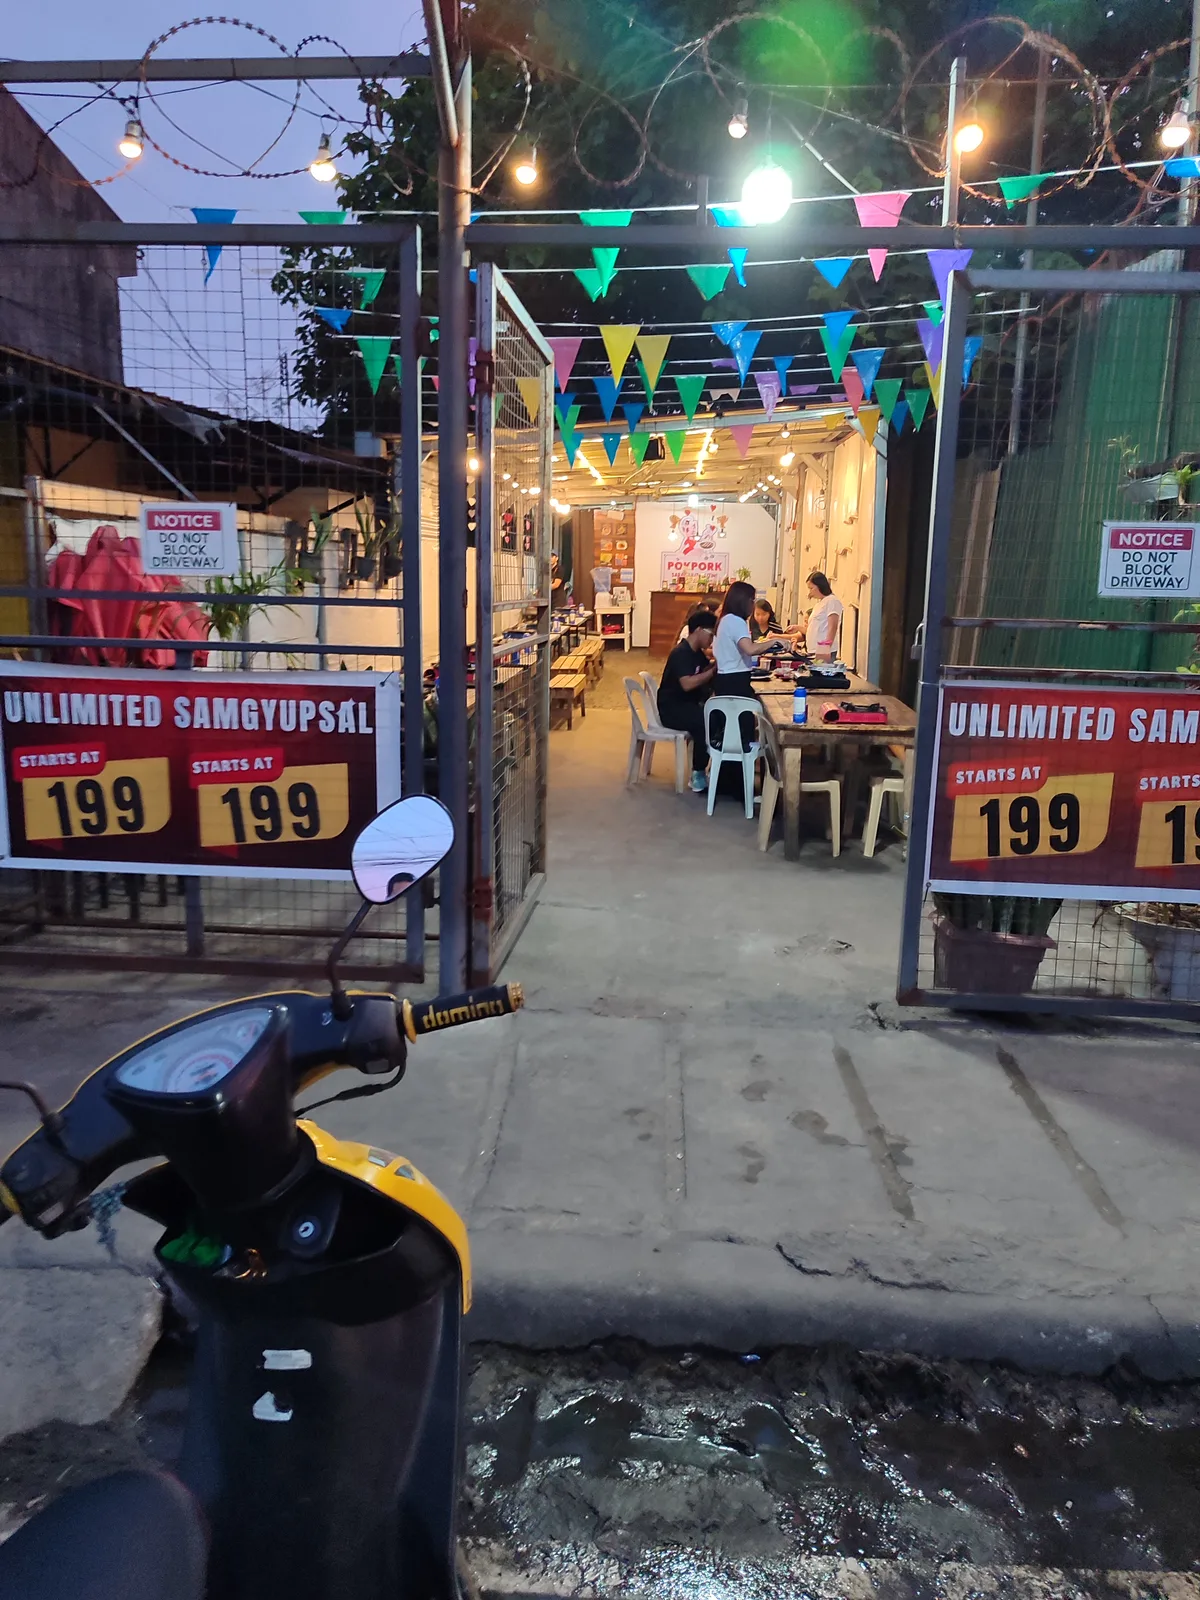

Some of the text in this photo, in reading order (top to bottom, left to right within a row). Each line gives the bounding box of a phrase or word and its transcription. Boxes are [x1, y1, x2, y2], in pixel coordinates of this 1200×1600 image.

[154, 514, 214, 527] NOTICE
[159, 532, 210, 543] DO NOT
[1119, 532, 1184, 546] NOTICE
[164, 545, 207, 555] BLOCK
[1122, 551, 1178, 563] DO NOT
[152, 556, 219, 568] DRIVEWAY
[1125, 564, 1172, 575] BLOCK
[1111, 576, 1185, 588] DRIVEWAY
[4, 690, 374, 735] UNLIMITED SAMGYUPSAL
[948, 702, 1115, 742] UNLIMITED
[19, 749, 100, 767] STARTS AT
[192, 756, 273, 774] STARTS AT
[956, 766, 1041, 784] STARTS AT
[1139, 774, 1200, 790] STARTS
[48, 775, 145, 837] 199
[222, 782, 321, 844] 199
[979, 792, 1081, 858] 199
[1164, 804, 1200, 864] 1
[422, 995, 505, 1029] domino
